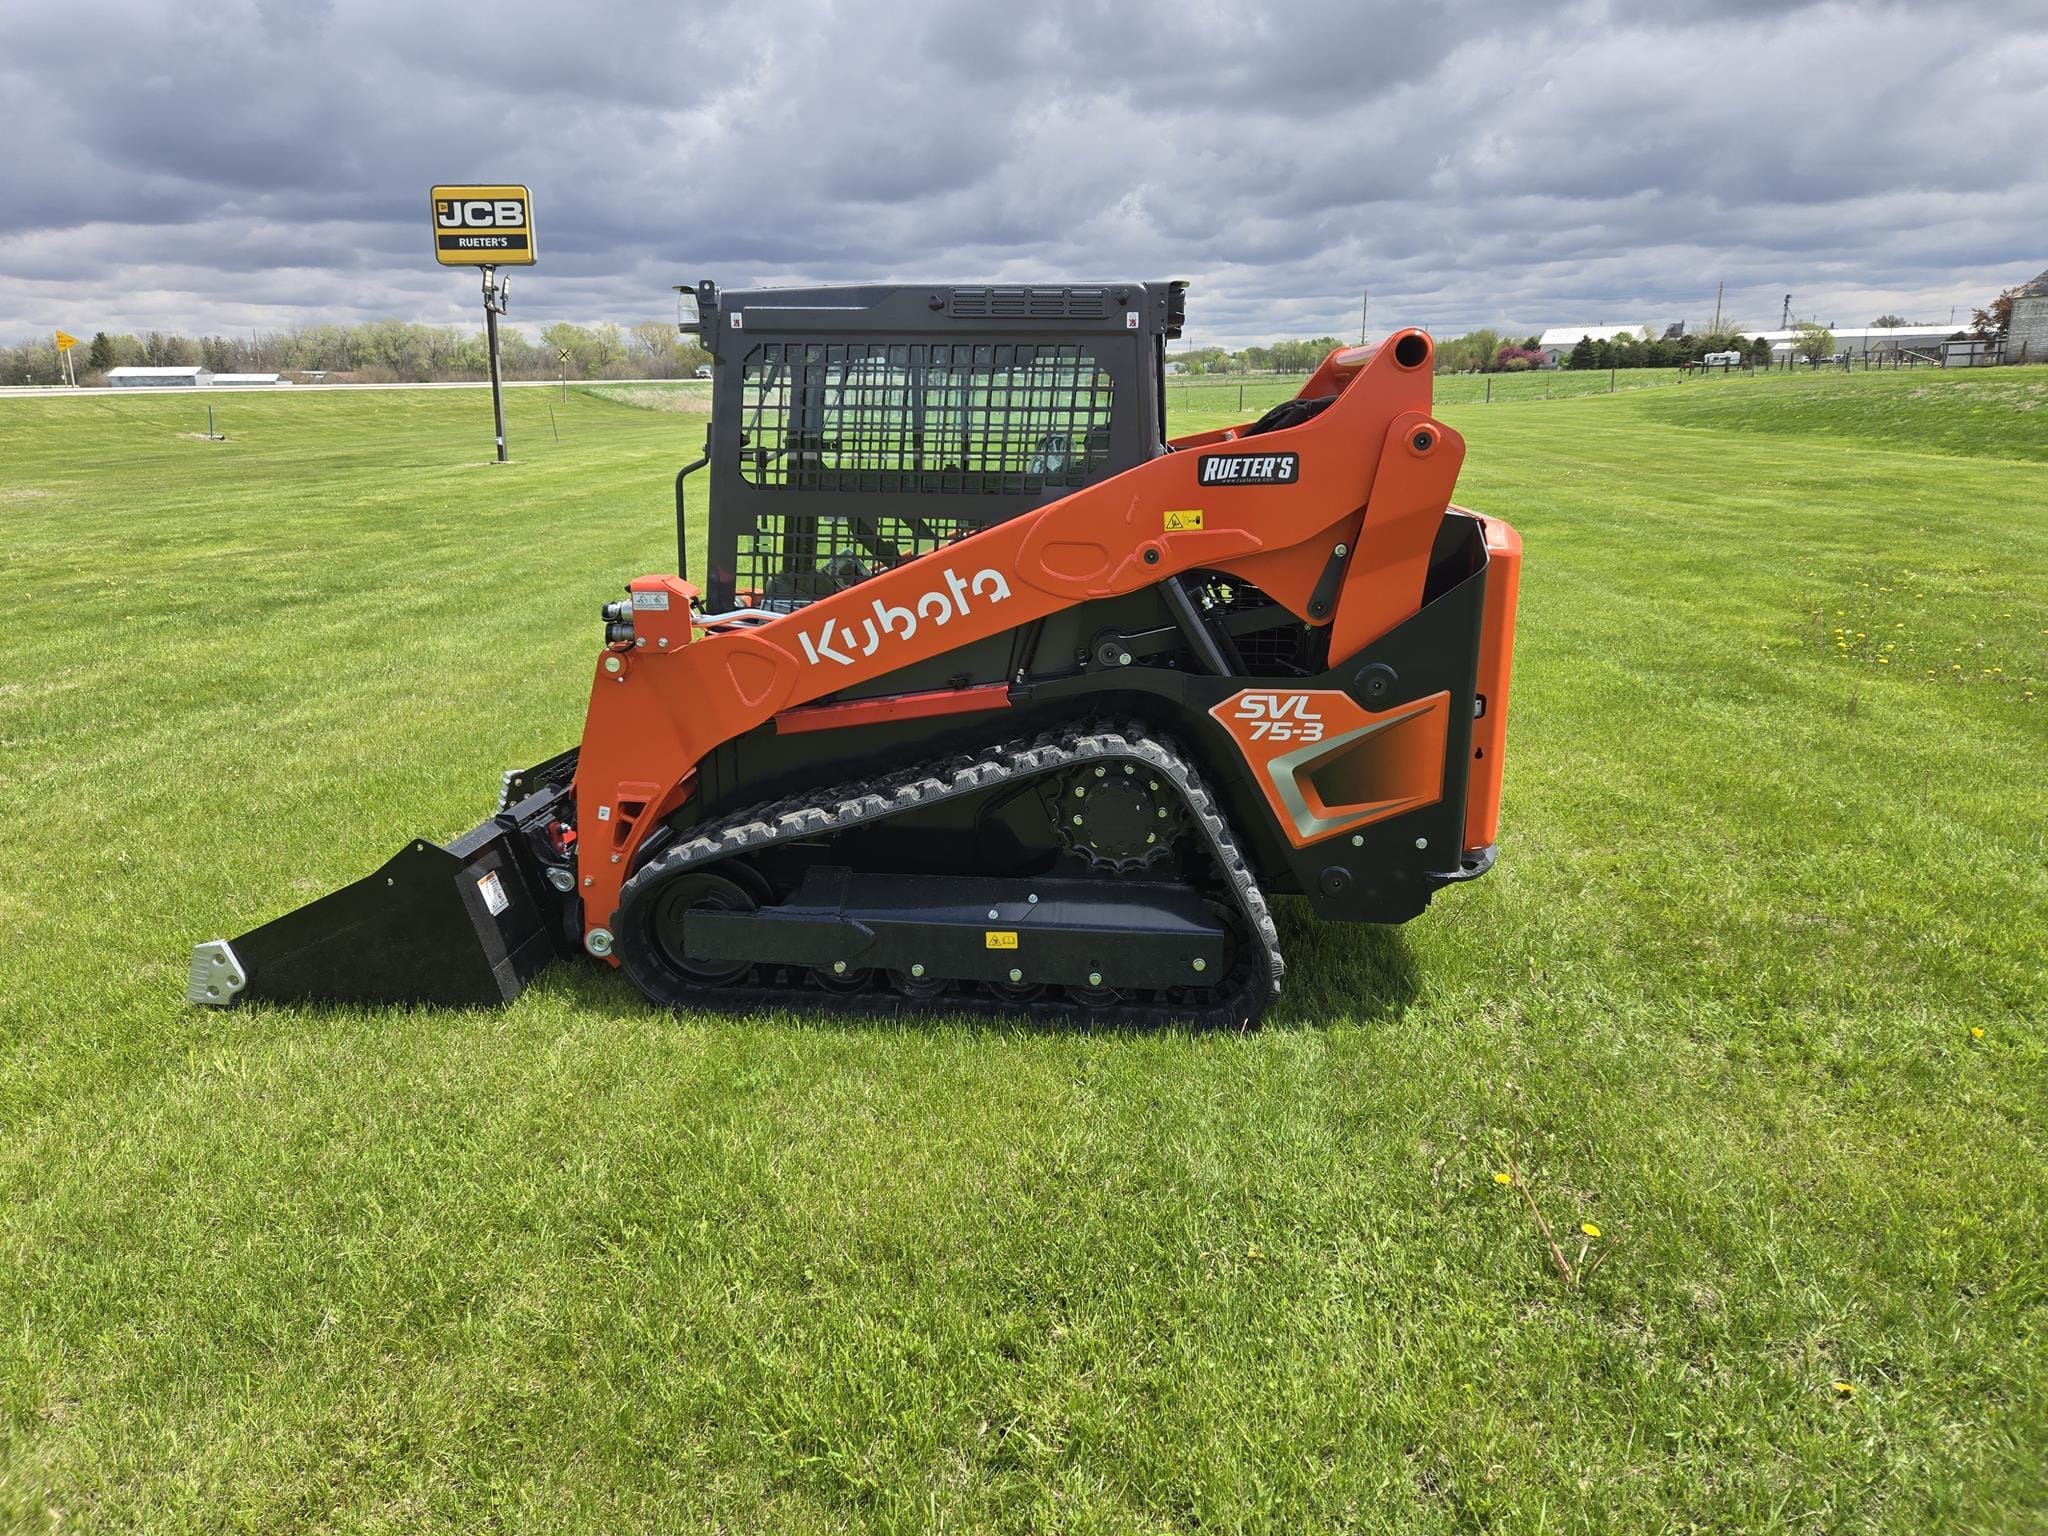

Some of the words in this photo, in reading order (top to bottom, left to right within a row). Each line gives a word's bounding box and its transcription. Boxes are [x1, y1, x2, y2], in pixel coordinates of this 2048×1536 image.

[438, 201, 524, 227] JCB
[459, 237, 508, 247] RUETER'S
[1203, 457, 1294, 481] RUETER'S
[797, 568, 1012, 665] Kubota
[1233, 695, 1322, 720] SVL
[1249, 721, 1324, 741] 75-3
